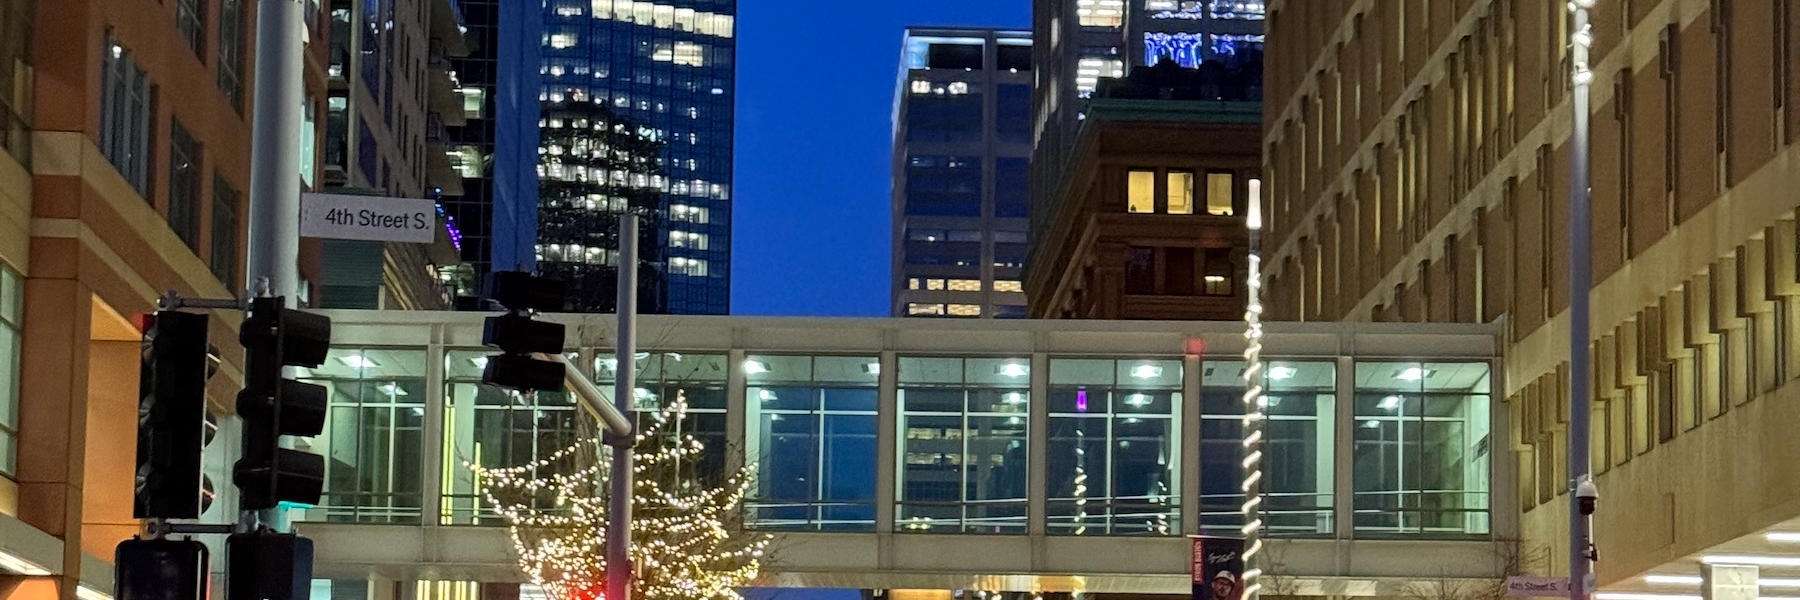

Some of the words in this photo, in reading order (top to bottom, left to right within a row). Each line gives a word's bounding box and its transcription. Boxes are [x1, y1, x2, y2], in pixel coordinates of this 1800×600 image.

[325, 208, 354, 226] 4th
[359, 209, 409, 229] Street
[414, 212, 430, 230] S.
[1524, 581, 1549, 592] Street
